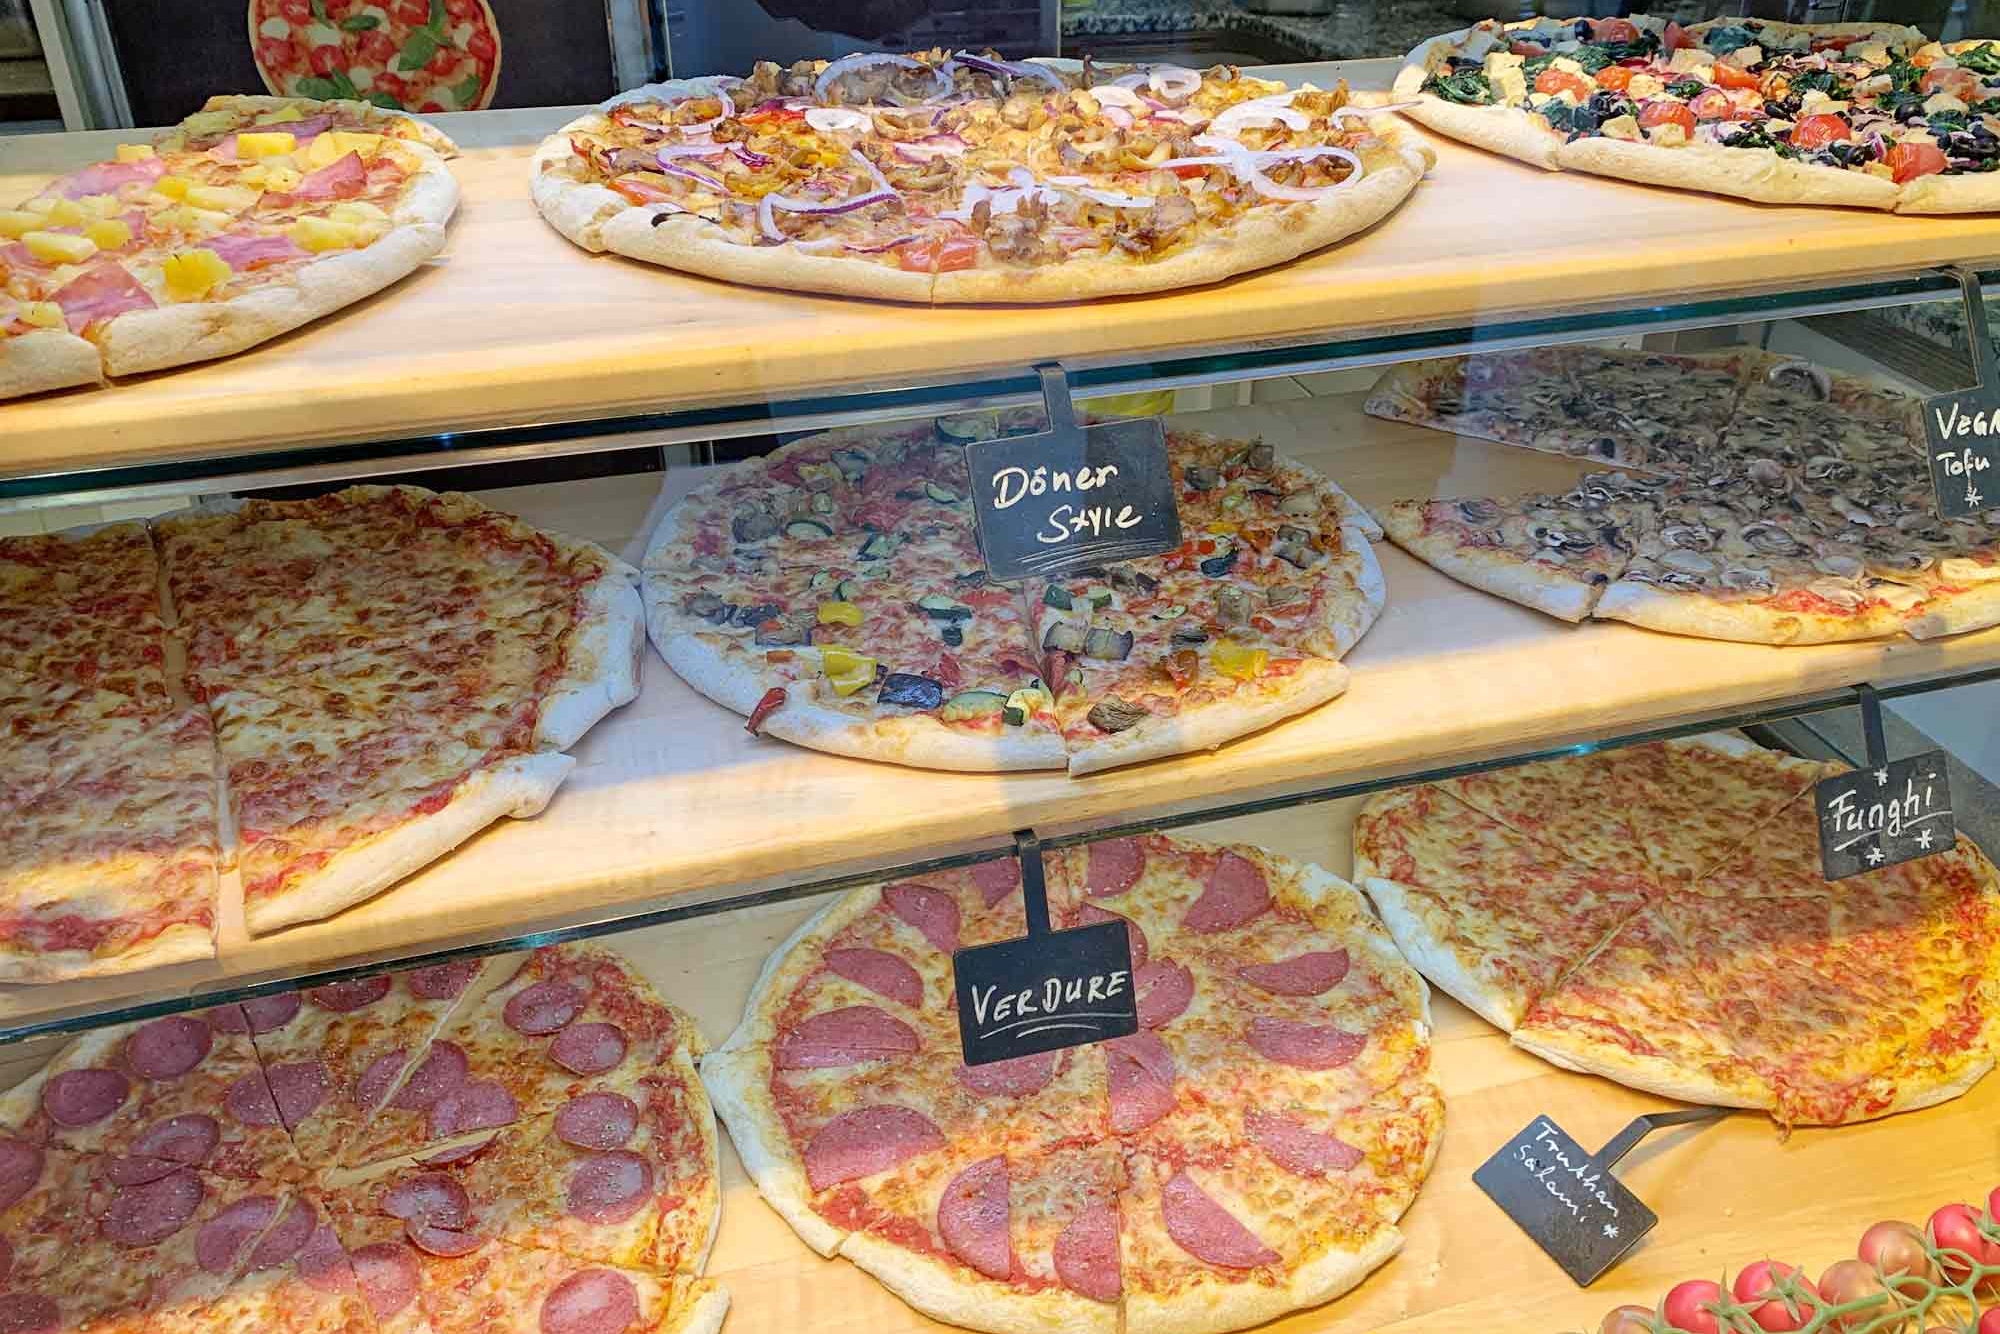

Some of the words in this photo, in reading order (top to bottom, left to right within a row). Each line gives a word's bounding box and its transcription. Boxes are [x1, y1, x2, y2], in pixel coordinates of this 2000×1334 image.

[1936, 447, 1991, 480] Tofu
[992, 464, 1118, 510] Döner
[1036, 504, 1143, 544] Style
[1828, 773, 1937, 837] Funghi
